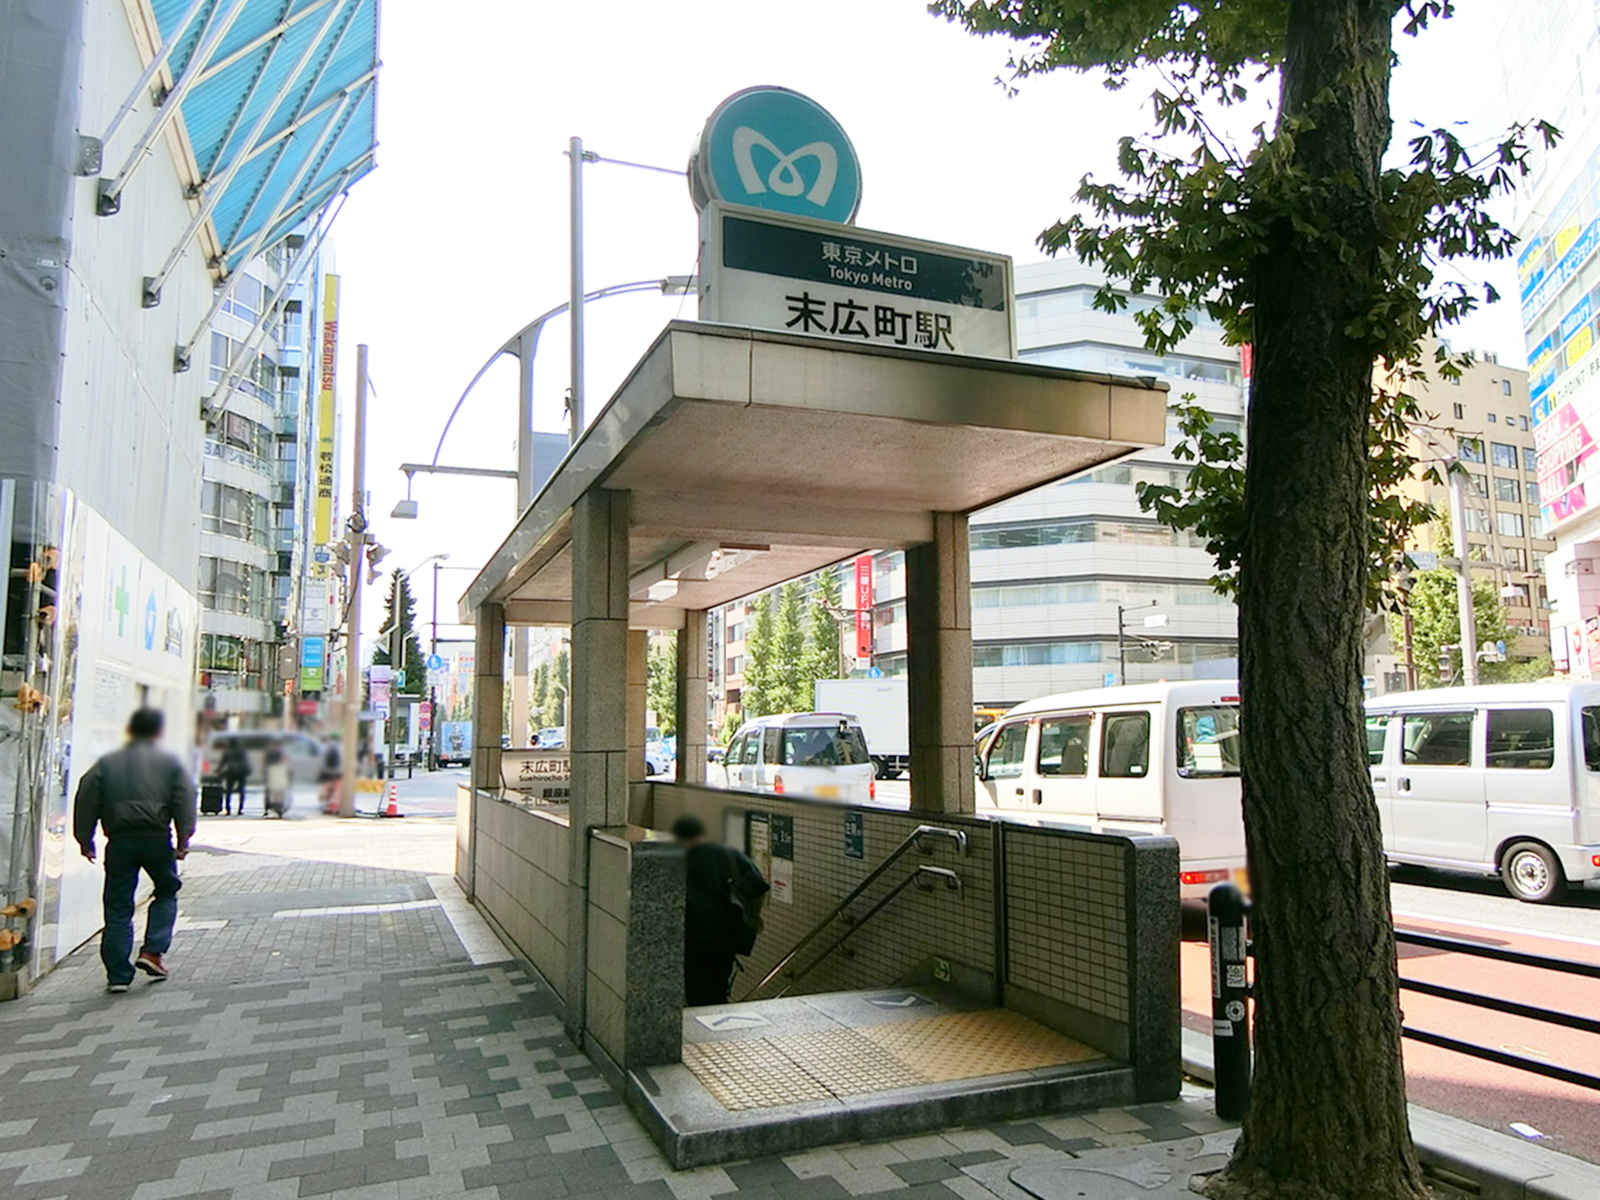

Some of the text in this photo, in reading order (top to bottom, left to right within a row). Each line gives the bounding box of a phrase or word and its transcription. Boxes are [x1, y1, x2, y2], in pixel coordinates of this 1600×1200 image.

[822, 241, 918, 274] 東京メトロ
[828, 264, 913, 291] Tokyo Metro
[784, 291, 955, 352] 末広町駅
[322, 321, 338, 391] Wakamatsu
[318, 451, 333, 498] 若松通商
[1538, 429, 1583, 476] SHOPPING
